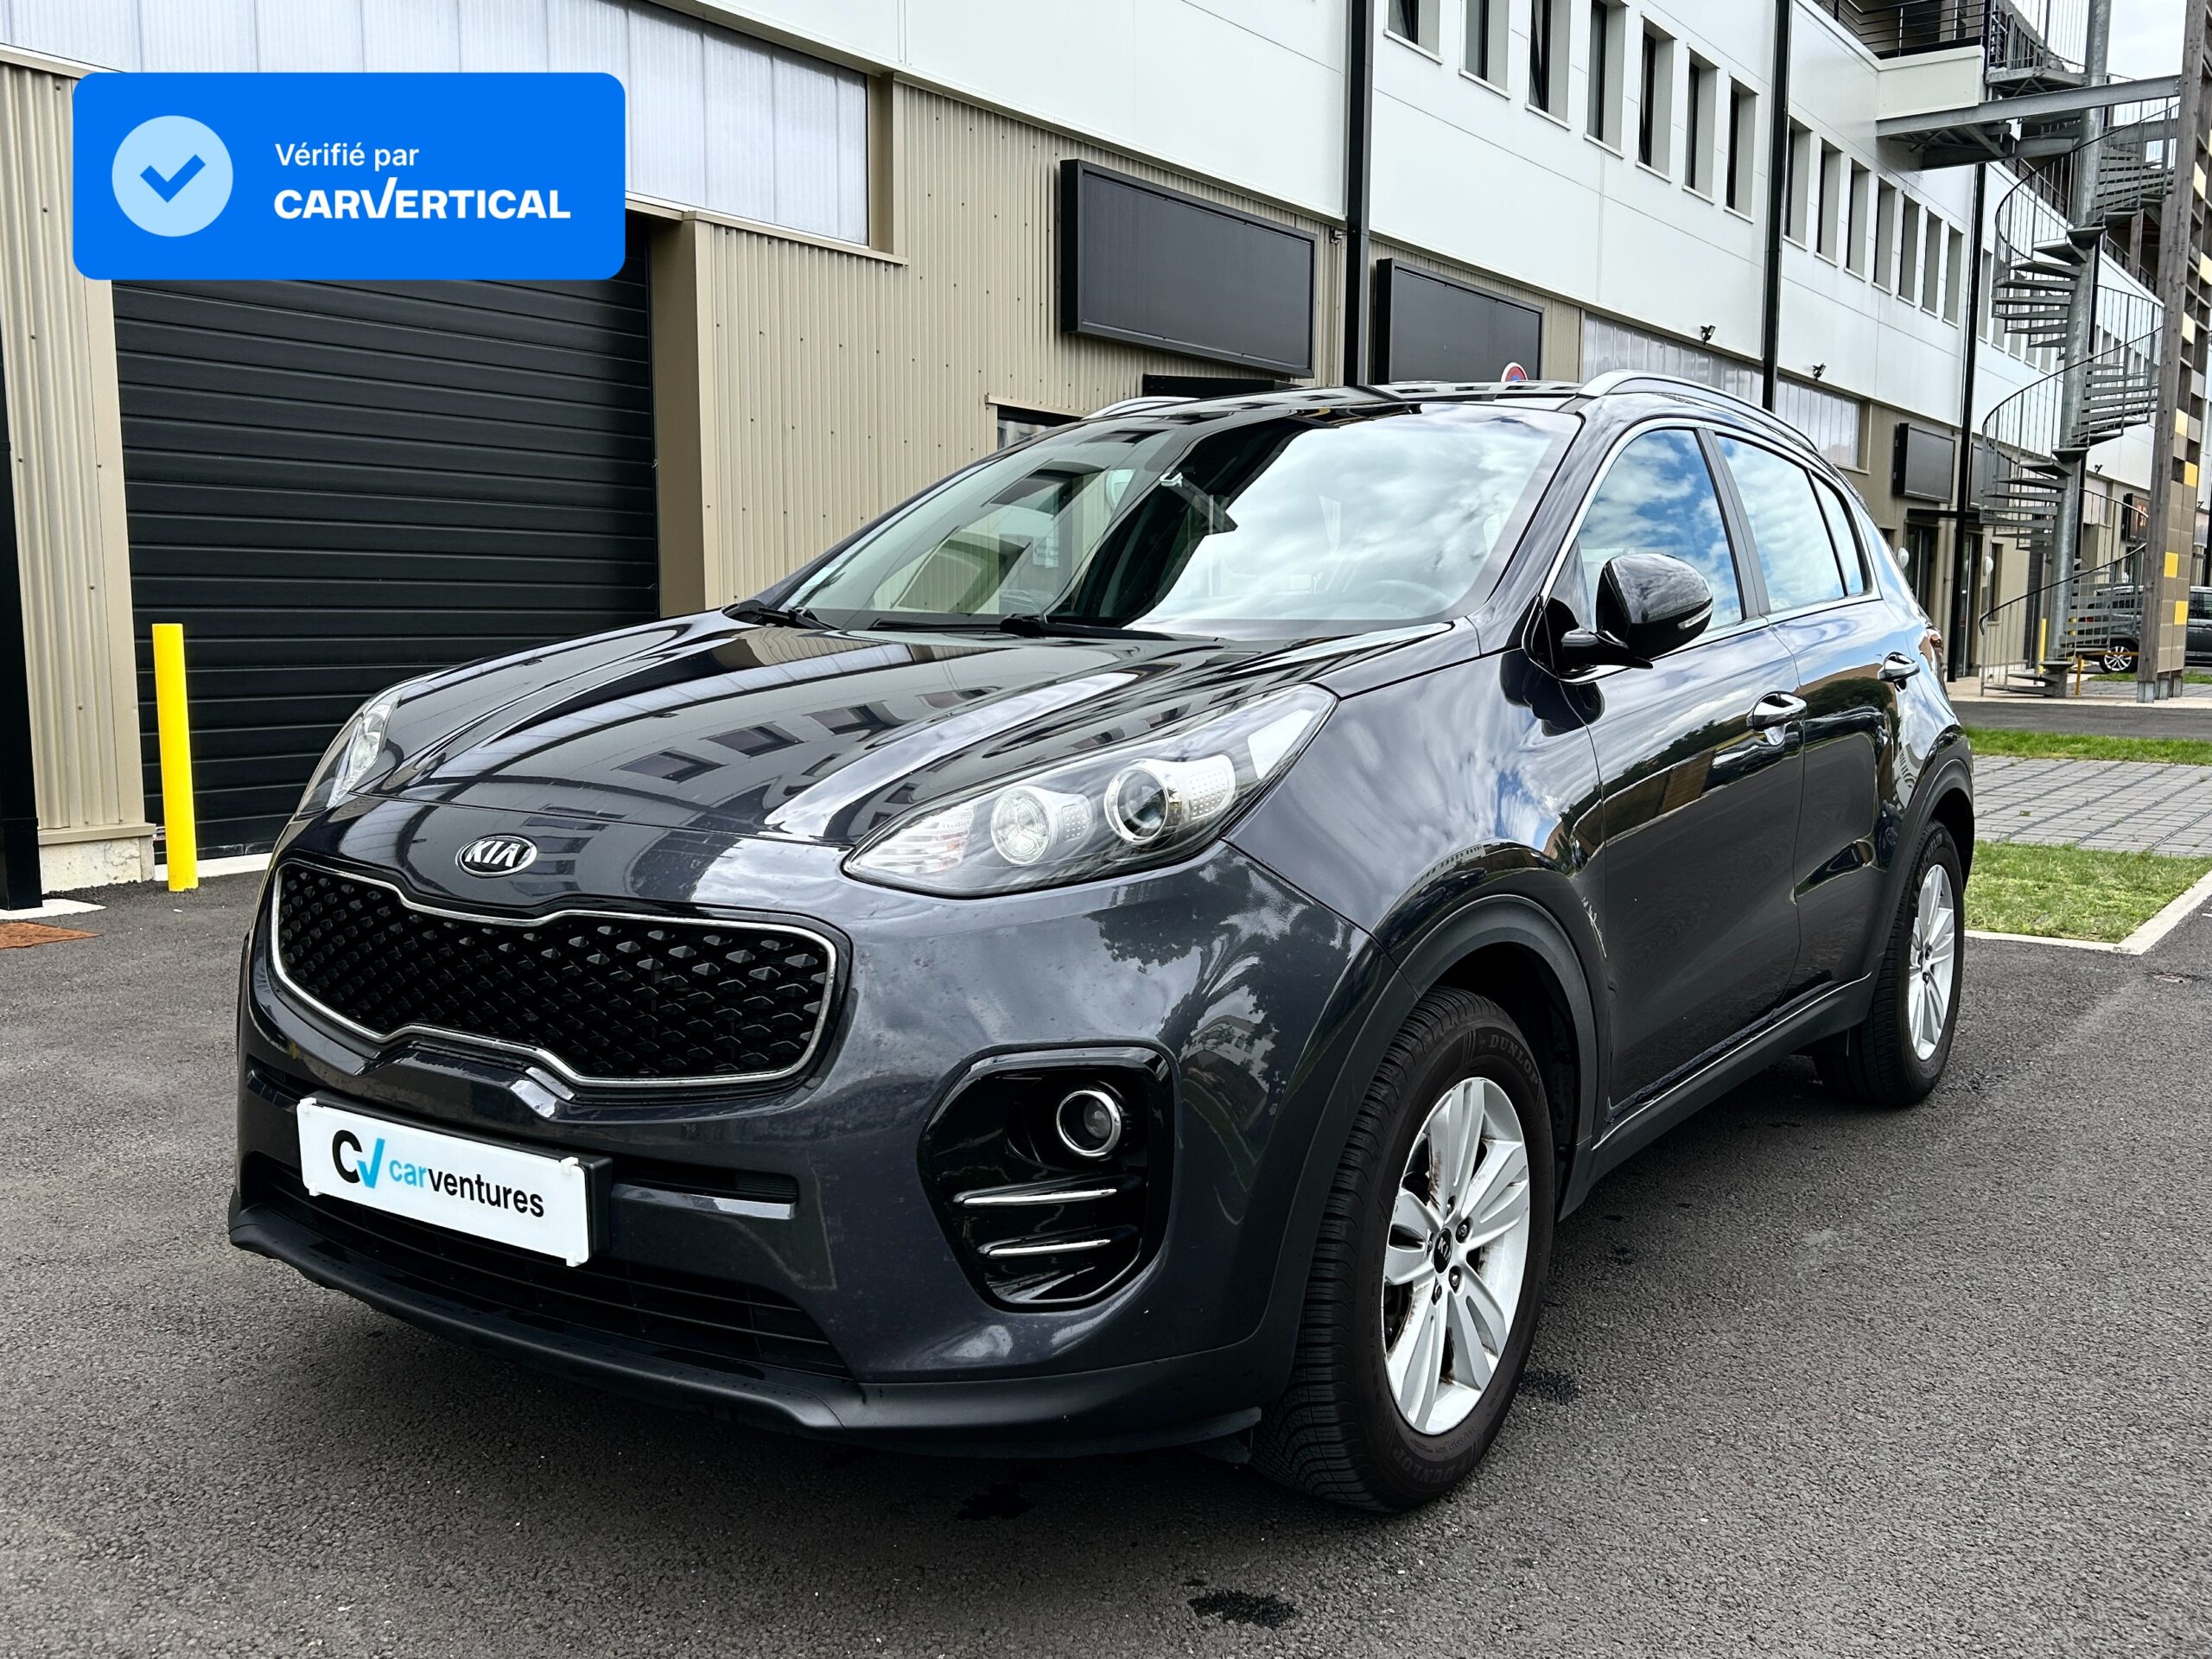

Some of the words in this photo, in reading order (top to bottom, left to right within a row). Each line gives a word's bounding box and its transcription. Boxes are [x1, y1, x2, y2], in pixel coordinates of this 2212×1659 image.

[464, 840, 522, 868] KIA
[1488, 1033, 1539, 1085] DUNLOP
[389, 1160, 545, 1218] carventures
